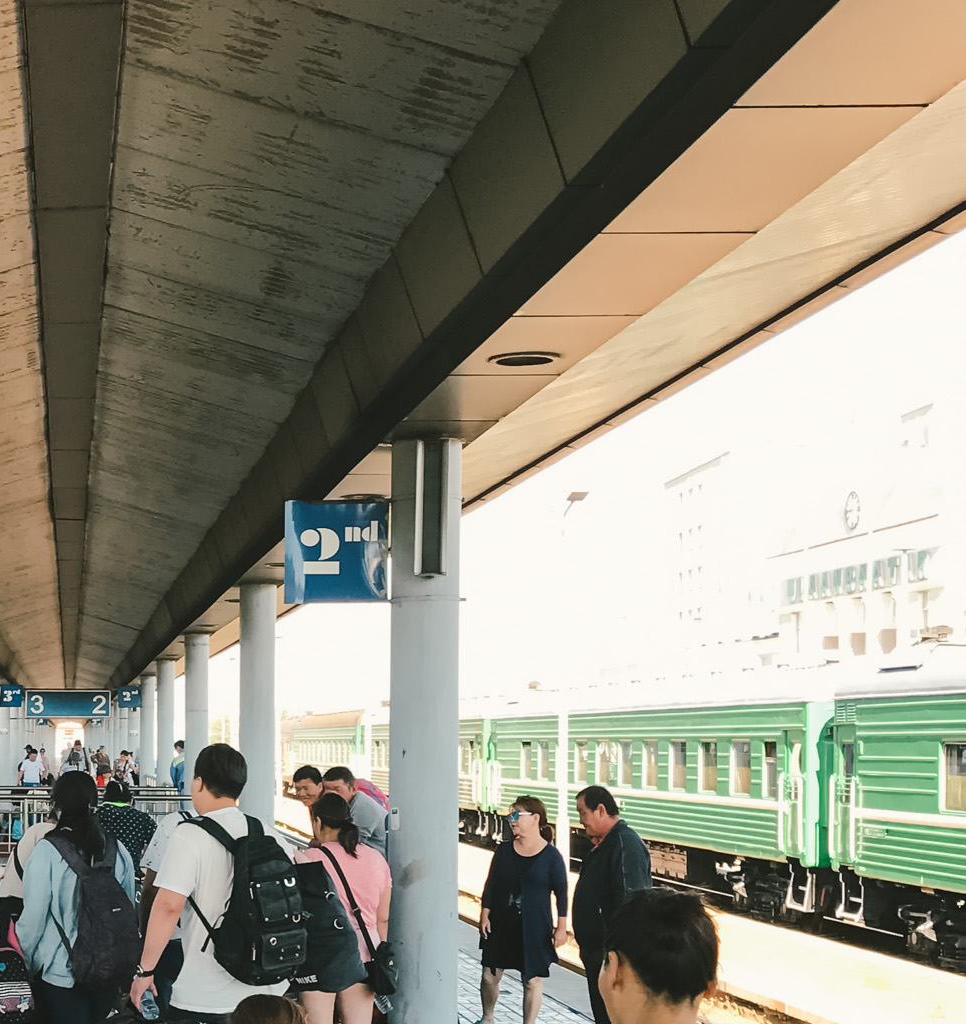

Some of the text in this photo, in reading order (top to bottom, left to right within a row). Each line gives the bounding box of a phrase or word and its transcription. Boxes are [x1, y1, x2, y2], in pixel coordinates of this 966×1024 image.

[300, 520, 378, 575] 2nd
[3, 689, 21, 702] 3rd
[30, 695, 44, 714] 3
[92, 695, 107, 714] 2
[295, 974, 318, 984] NIKE
